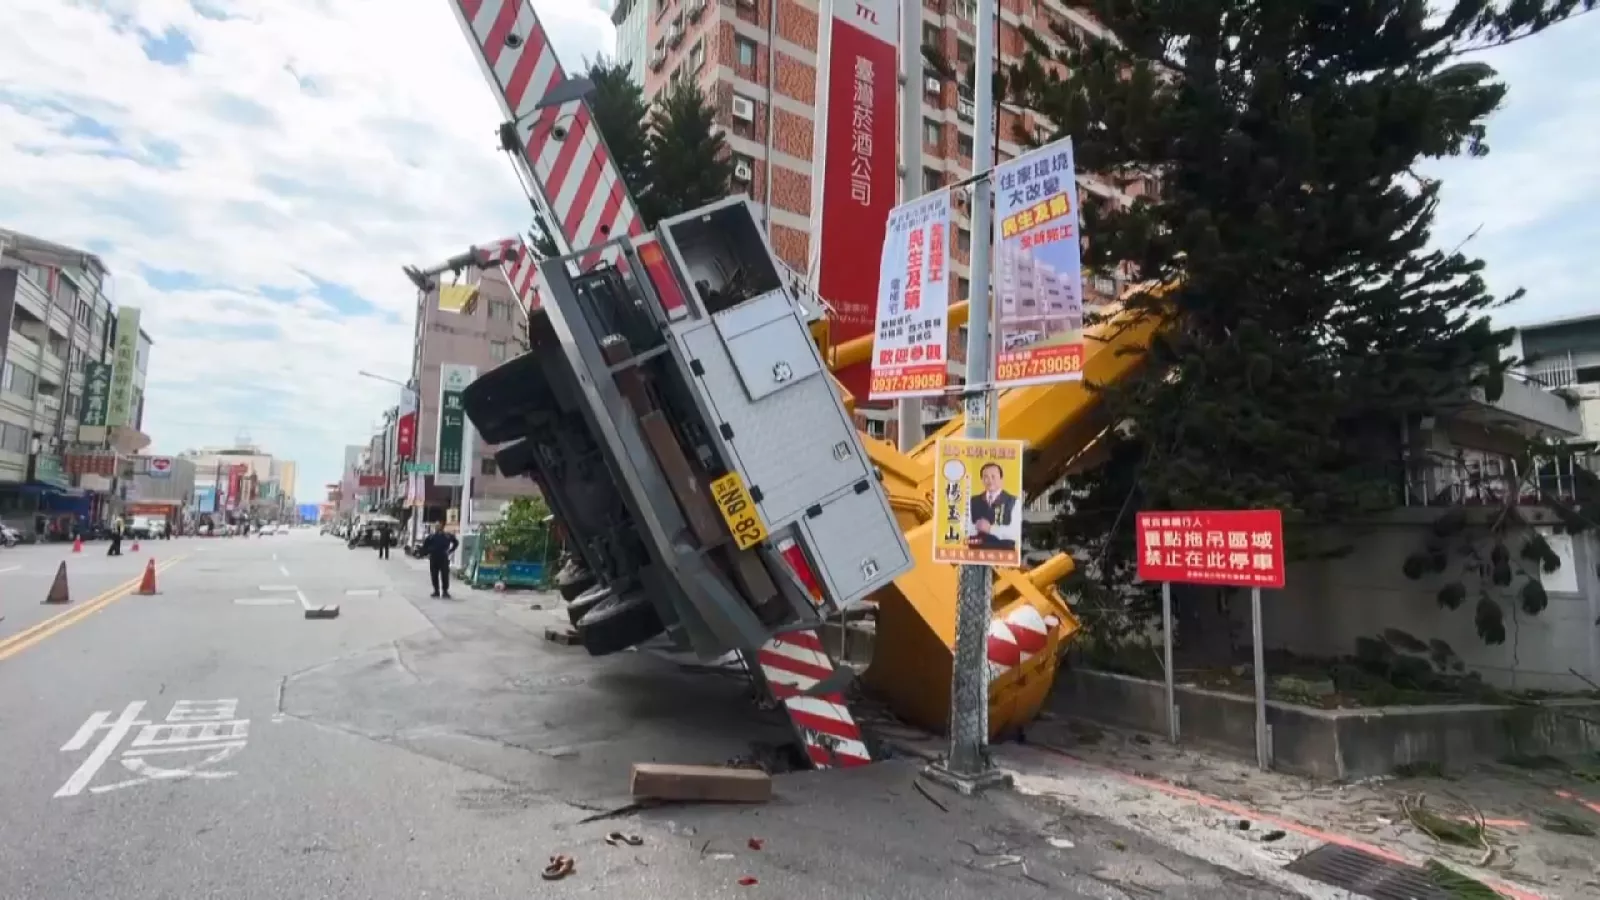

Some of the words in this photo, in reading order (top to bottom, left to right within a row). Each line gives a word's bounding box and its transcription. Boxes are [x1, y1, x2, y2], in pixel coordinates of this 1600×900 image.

[855, 3, 880, 26] TTL
[850, 54, 876, 207] 臺灣菸酒公司
[1000, 151, 1069, 191] 住家環境
[1008, 177, 1061, 208] 大改變
[879, 343, 942, 366] 歡迎參觀
[997, 354, 1081, 381] 0937-739058
[872, 374, 944, 394] 0937-739058
[1144, 529, 1274, 550] 重點拖吊區域
[1144, 549, 1274, 571] 禁止在此停車
[53, 697, 251, 798] 慢
